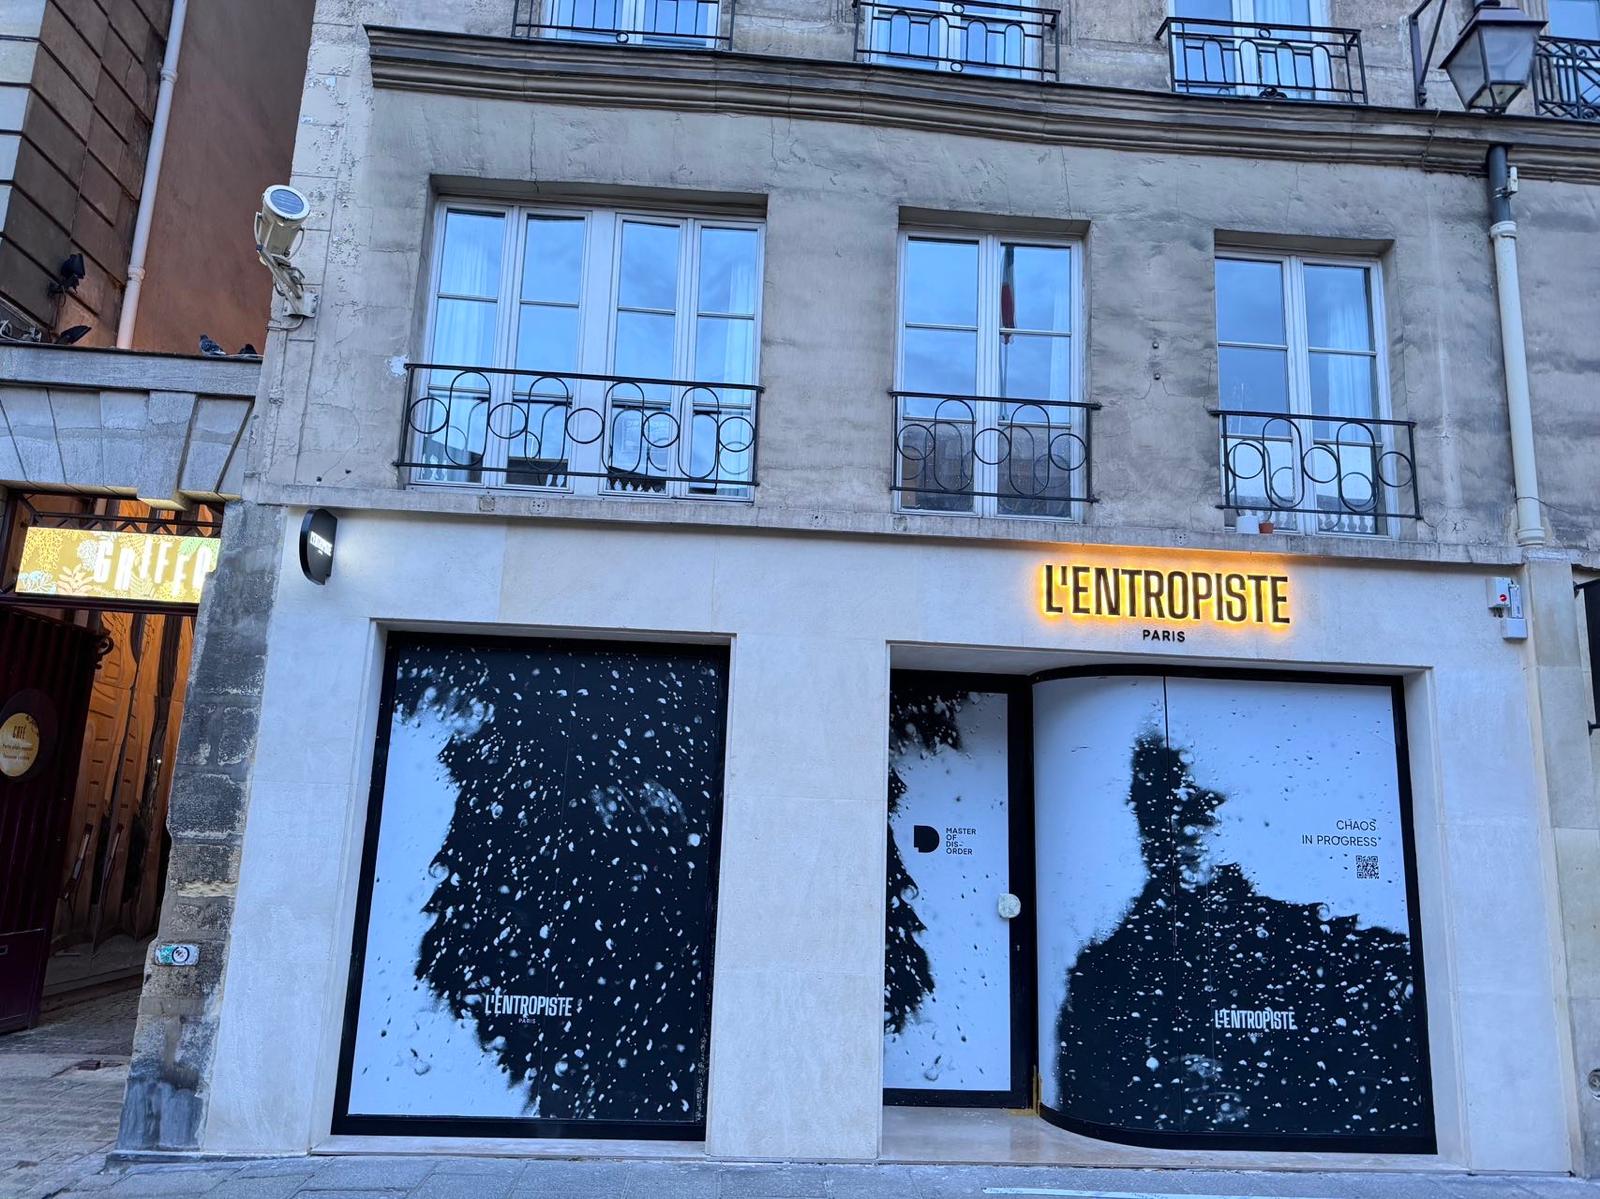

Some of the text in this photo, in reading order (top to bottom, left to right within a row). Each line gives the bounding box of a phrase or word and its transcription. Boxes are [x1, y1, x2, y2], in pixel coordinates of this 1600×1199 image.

[1045, 564, 1290, 624] L'ENTROPISTE
[1143, 629, 1186, 643] PARIS
[946, 827, 977, 835] MASTER
[1336, 819, 1377, 832] CHAOS
[1302, 834, 1378, 848] IN PROGRESS
[946, 847, 973, 855] ORDER
[484, 994, 574, 1017] L'ENTROPISTE
[1215, 1009, 1298, 1030] L'ENTROPISTE
